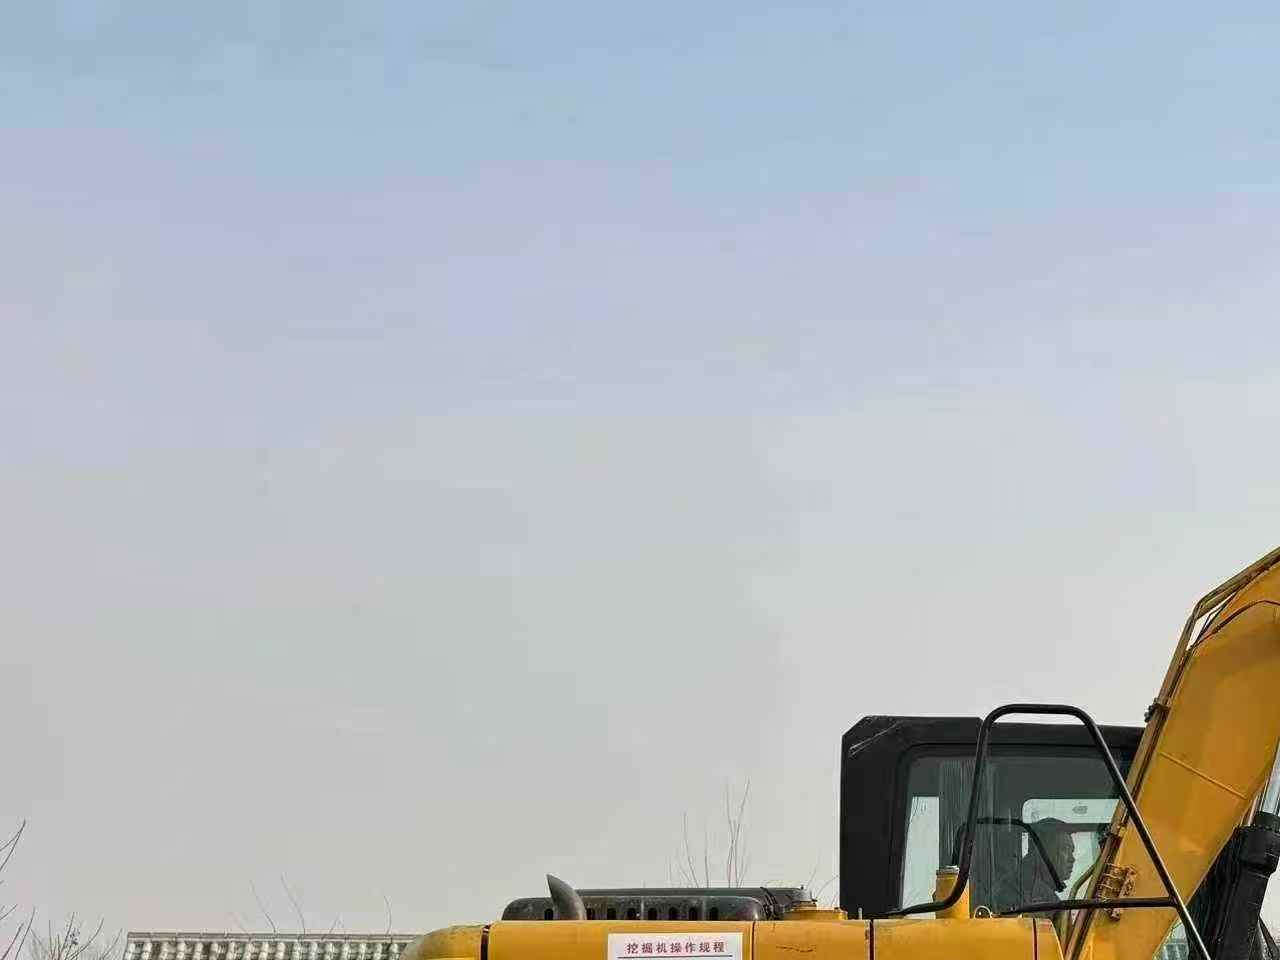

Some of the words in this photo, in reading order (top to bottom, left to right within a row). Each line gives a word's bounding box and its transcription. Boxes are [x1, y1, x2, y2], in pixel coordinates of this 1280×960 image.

[626, 941, 726, 955] 挖掘机操作规程
